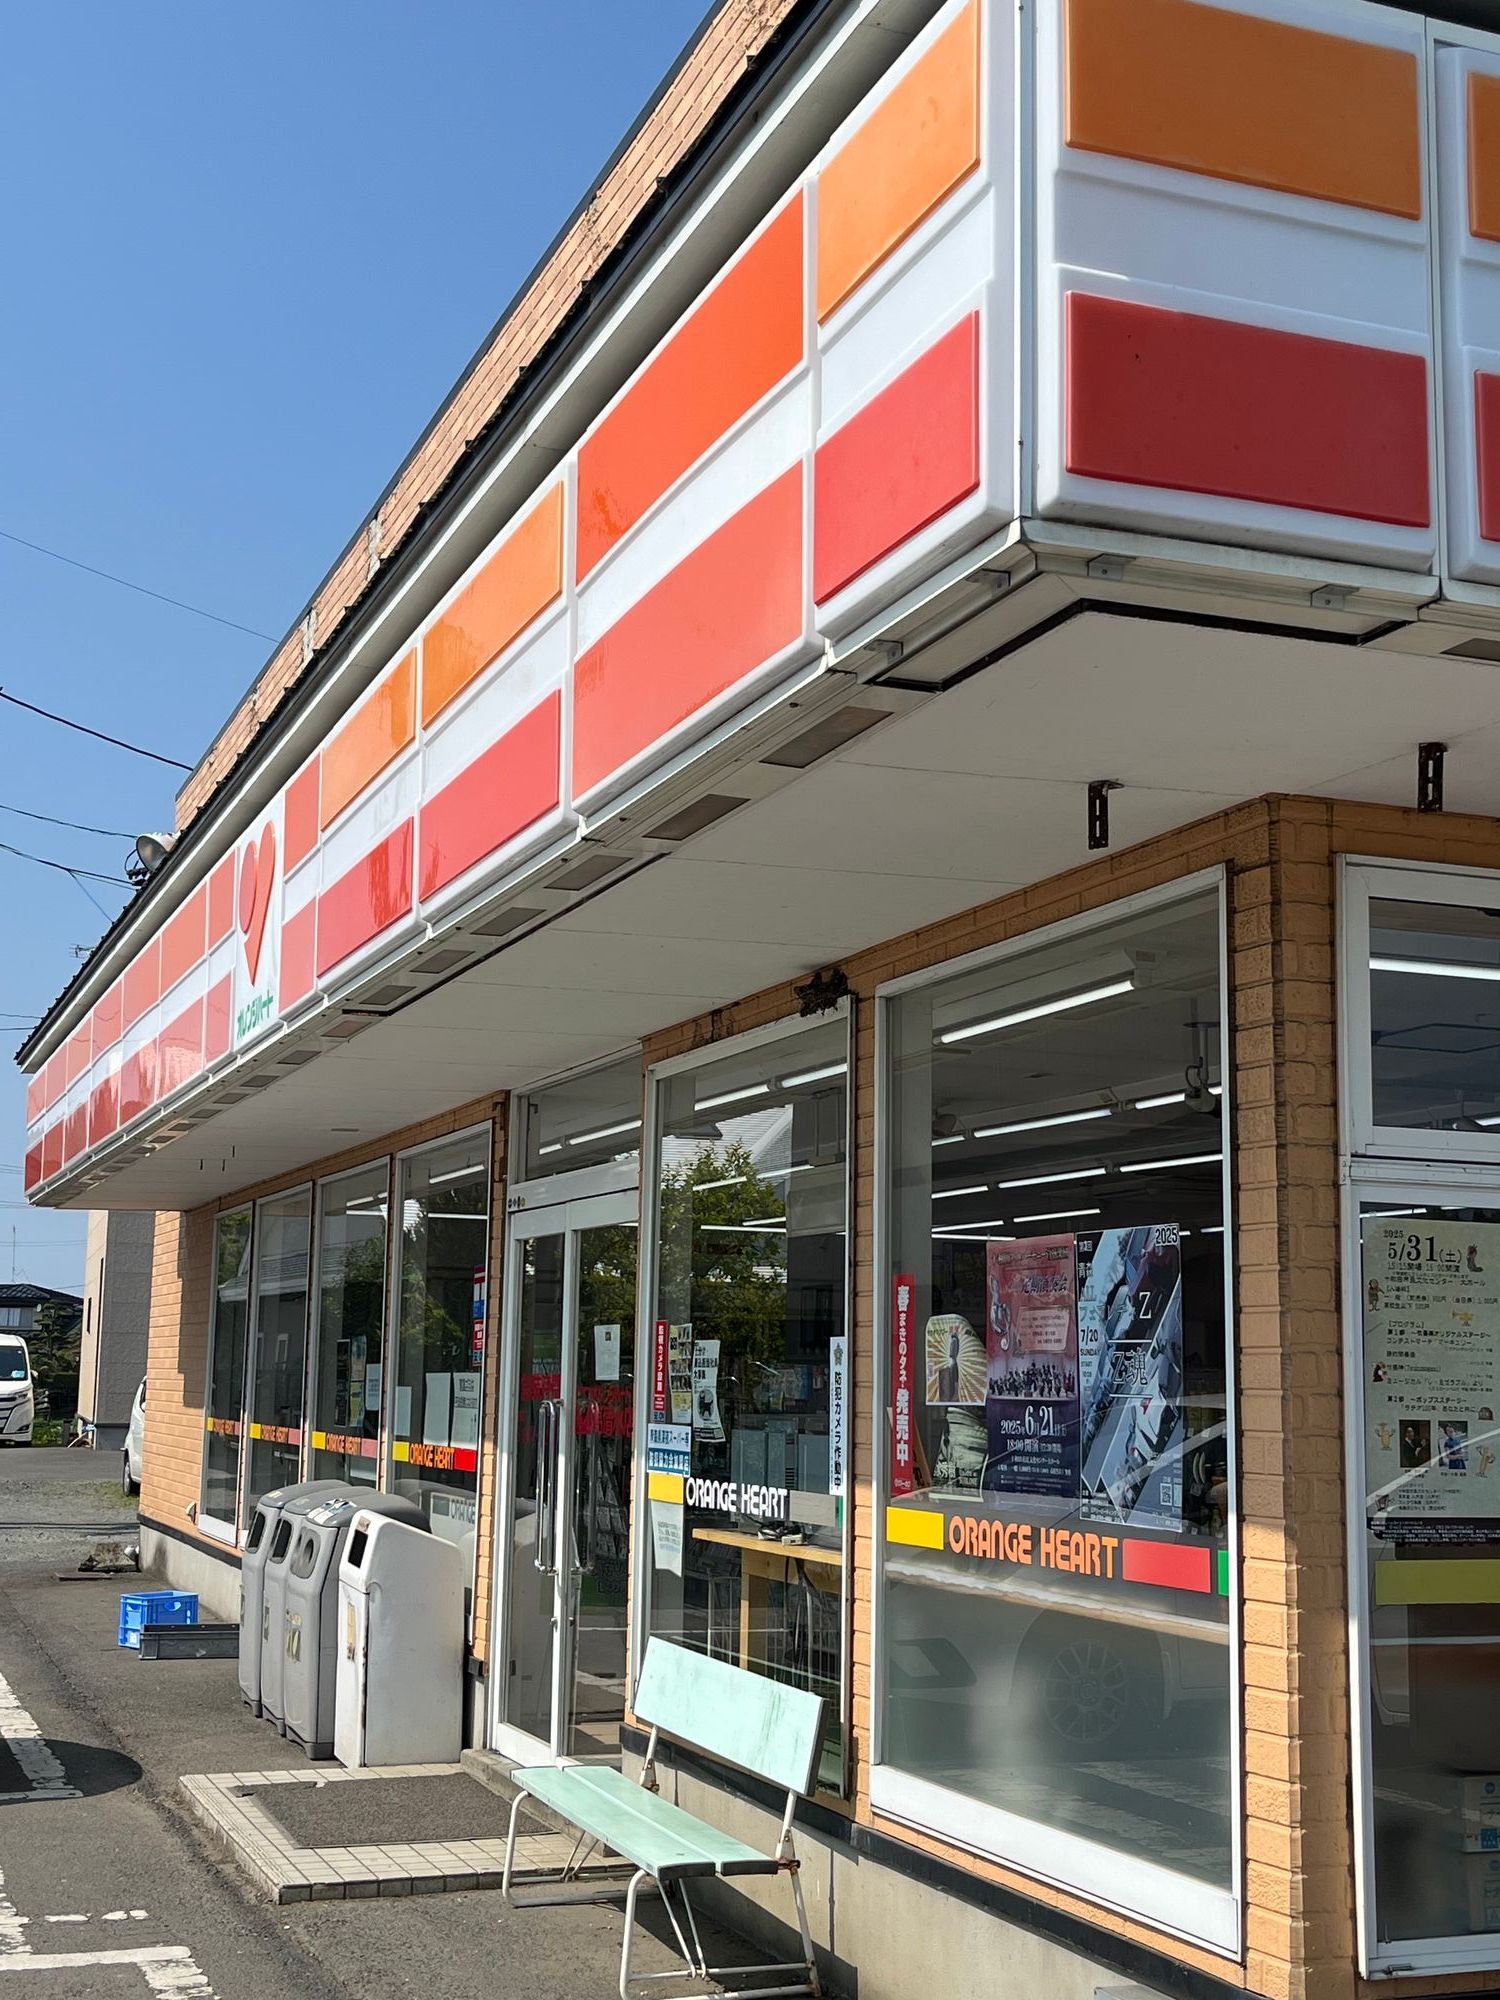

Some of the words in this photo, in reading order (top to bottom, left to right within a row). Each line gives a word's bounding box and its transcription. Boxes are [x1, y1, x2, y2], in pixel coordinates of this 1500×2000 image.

[1154, 1228, 1179, 1246] 2025
[1383, 1229, 1404, 1239] 2025
[1138, 1290, 1152, 1320] Z
[1080, 1327, 1098, 1345] 7/20
[326, 1433, 345, 1454] ORANGE
[345, 1436, 362, 1457] HEART
[410, 1442, 433, 1468] ORANGE
[434, 1446, 455, 1470] HEART
[685, 1477, 737, 1512] ORANGE
[740, 1484, 788, 1519] HEART
[948, 1514, 1034, 1565] ORANGE
[1039, 1527, 1119, 1580] HEART
